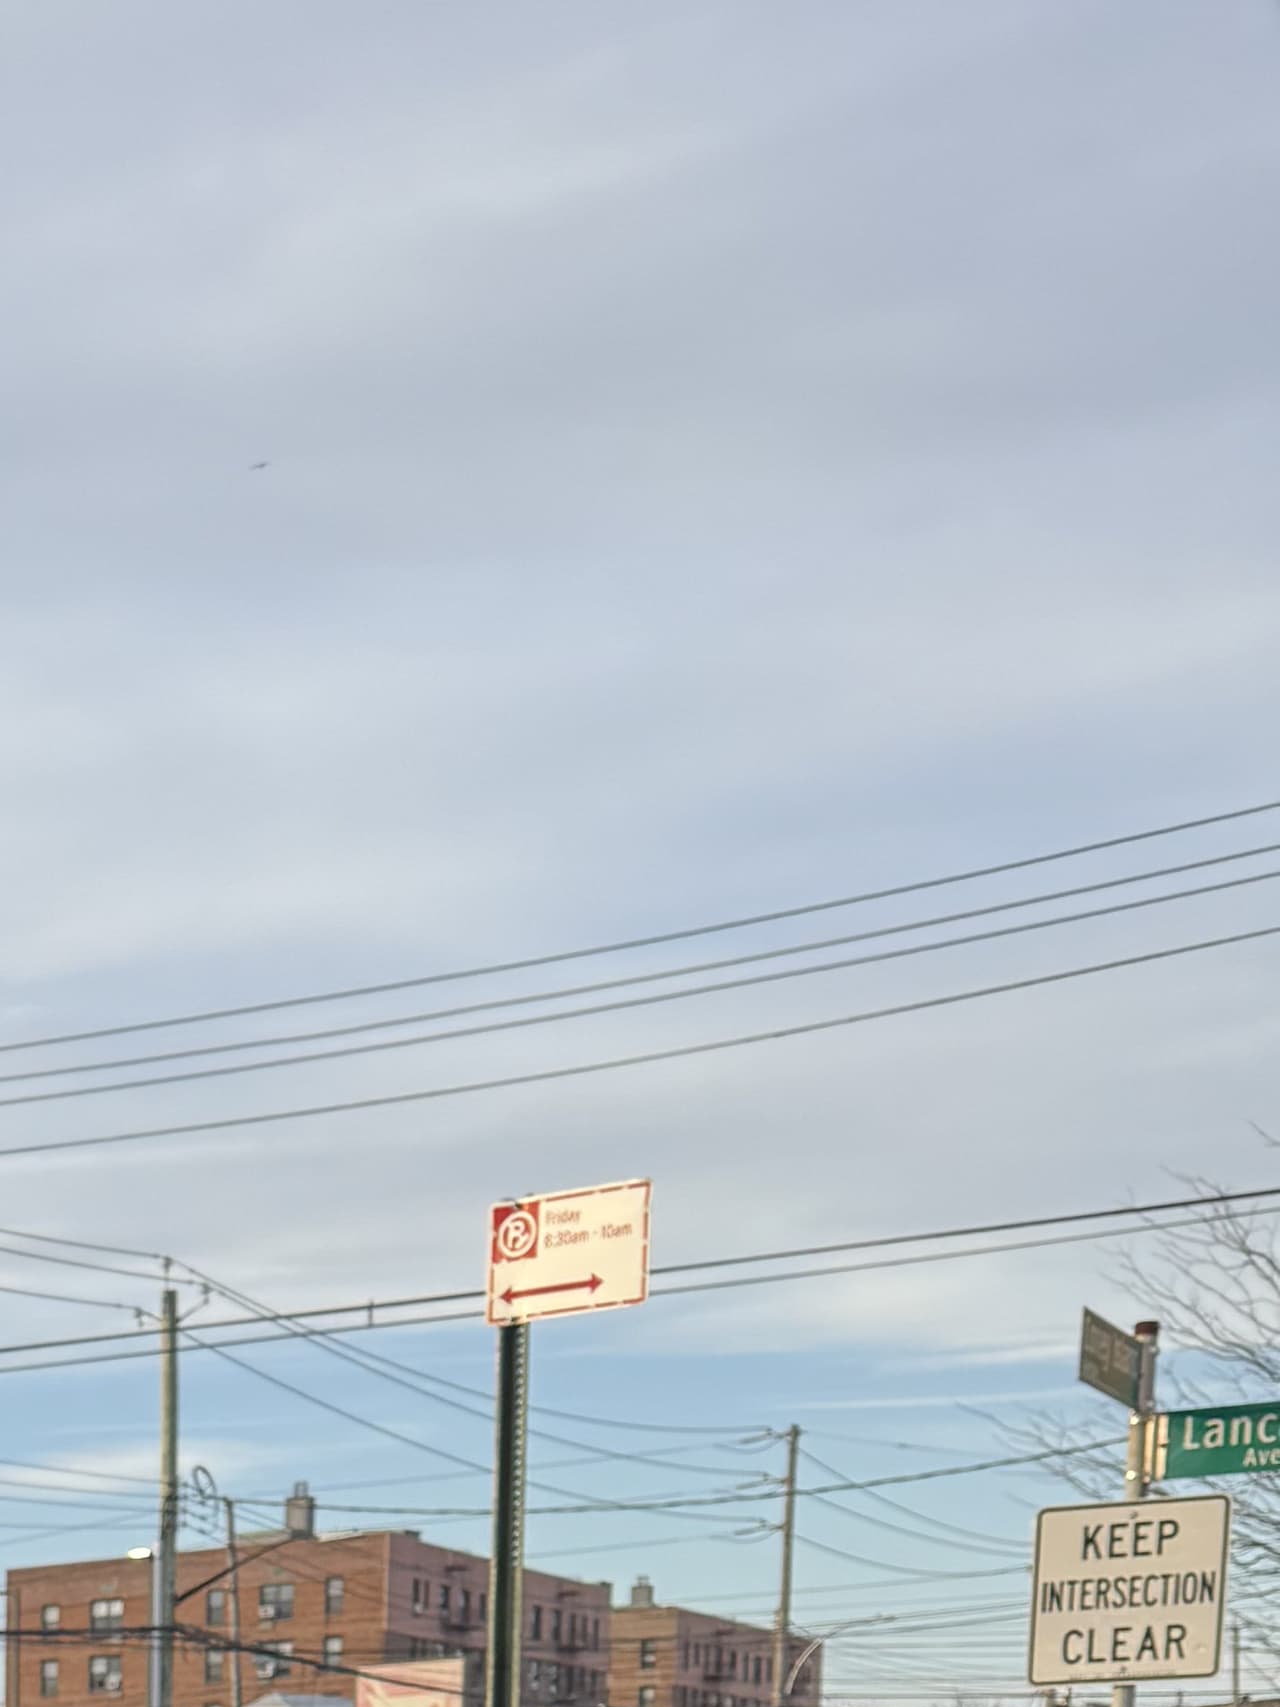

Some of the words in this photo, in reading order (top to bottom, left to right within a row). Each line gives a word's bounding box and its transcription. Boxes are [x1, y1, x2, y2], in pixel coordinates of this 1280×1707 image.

[1183, 1412, 1280, 1451] Lanc
[1081, 1518, 1180, 1561] KEEP
[1040, 1570, 1217, 1614] INTERSECTION
[1062, 1623, 1188, 1666] CLEAR
